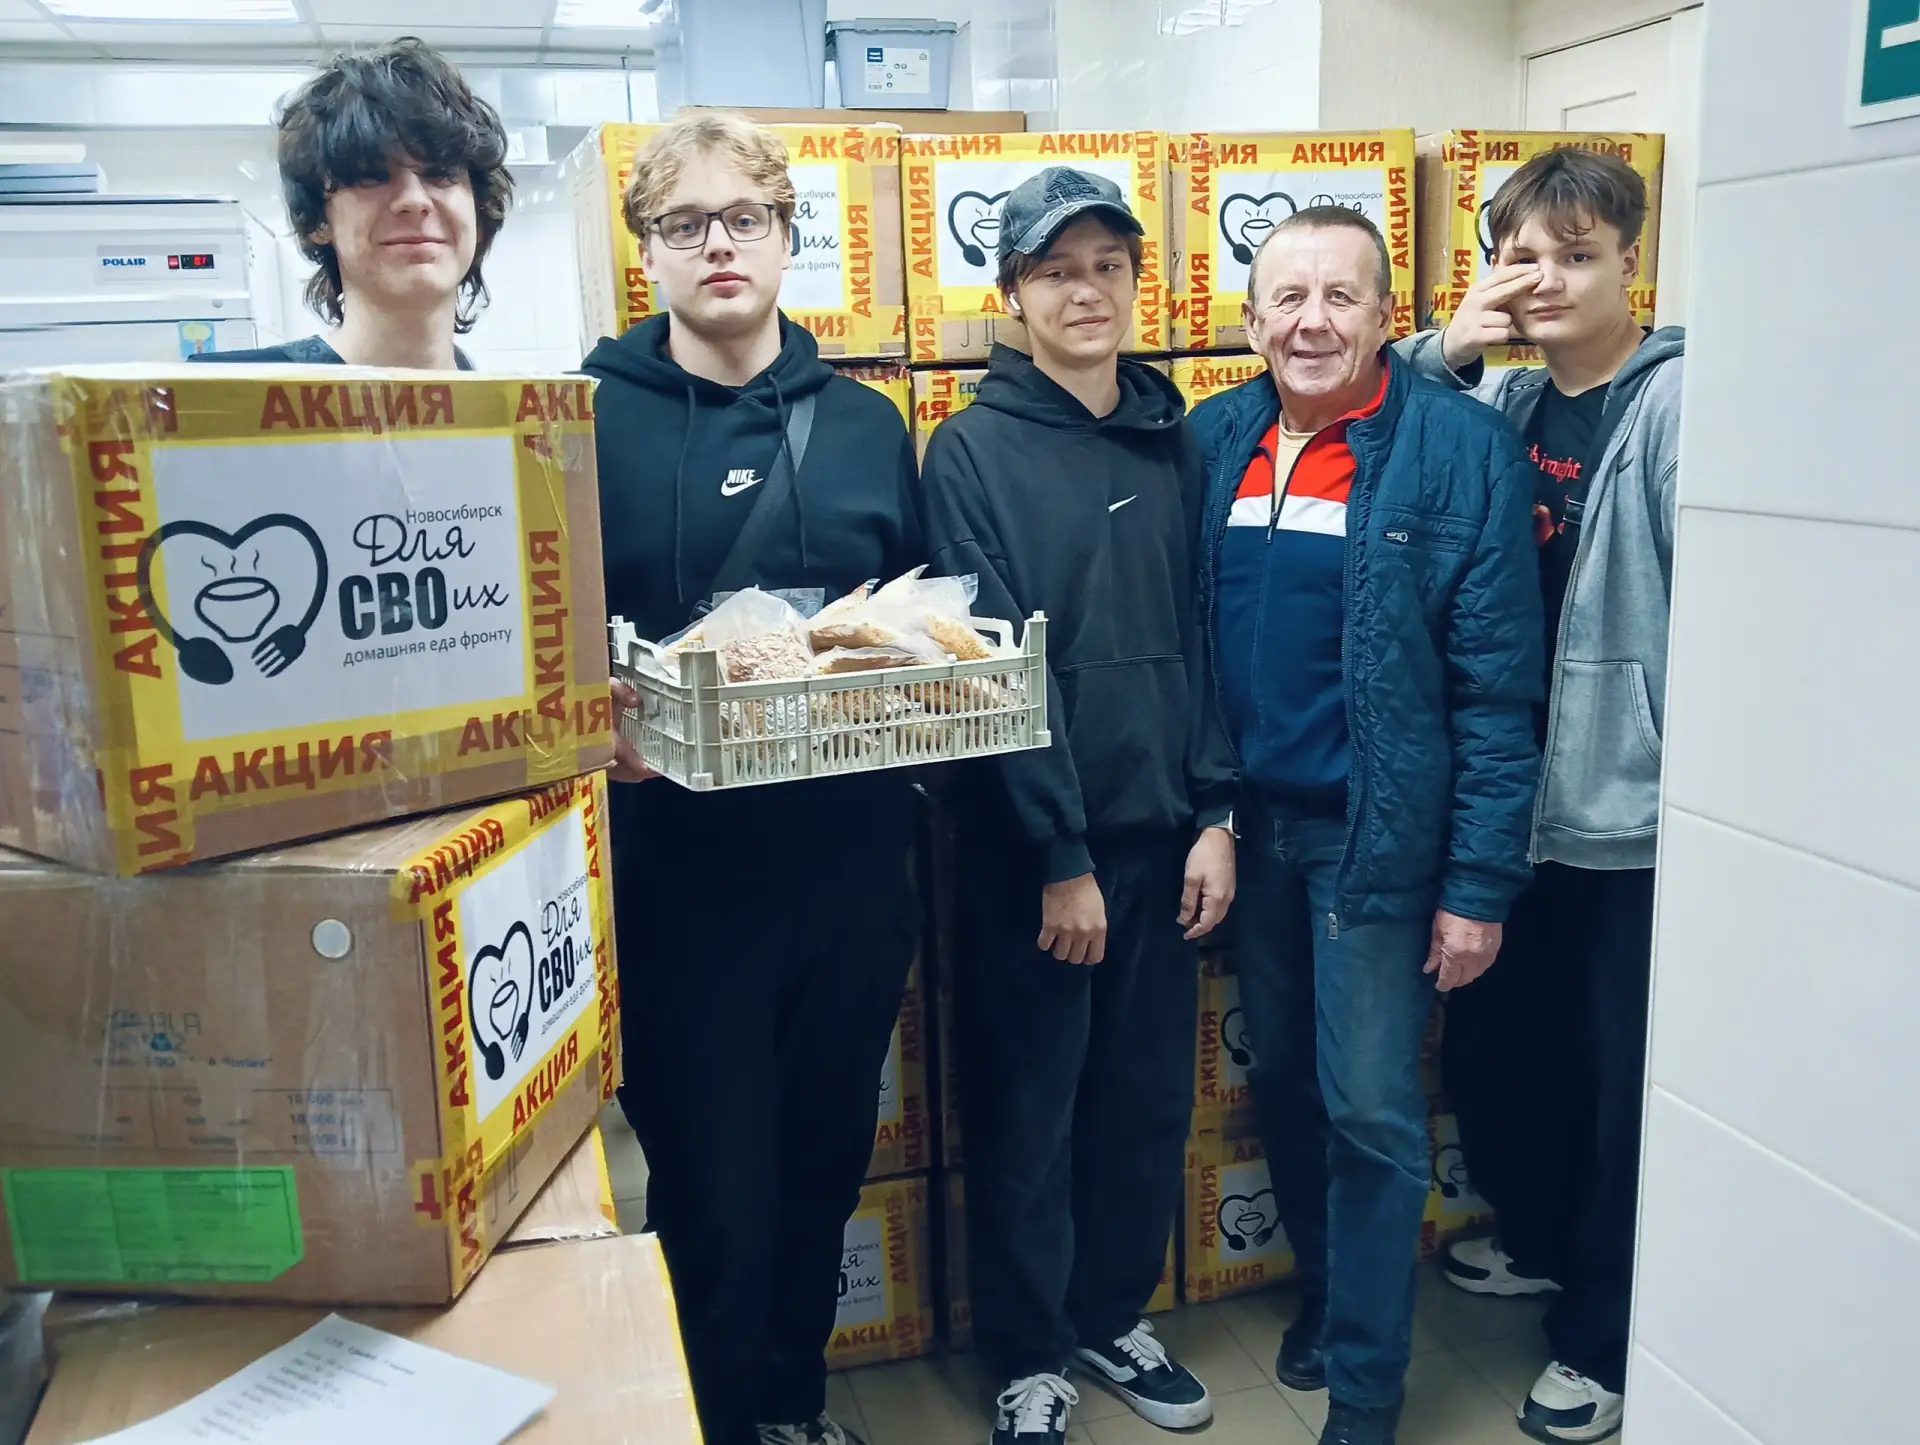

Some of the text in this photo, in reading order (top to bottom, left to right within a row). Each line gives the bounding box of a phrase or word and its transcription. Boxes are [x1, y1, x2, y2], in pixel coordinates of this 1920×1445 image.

[798, 136, 898, 158] АКИЯ
[1291, 142, 1385, 166] АКЦИЯ
[909, 166, 935, 279] АКЦИЯ
[1388, 167, 1411, 269] АКЦИЯ
[102, 258, 147, 267] POLAIR
[848, 204, 873, 318] АКЦИЯ
[260, 383, 455, 435] АКЦИЯ
[405, 503, 502, 525] Новосибирск
[726, 469, 756, 484] NIKE
[88, 440, 163, 680] АКЦИЯ
[352, 513, 476, 567] Для
[343, 627, 513, 668] домашняя еда фронту
[528, 530, 569, 721] АКЦИЯ
[189, 729, 393, 802] АКЦИЯ
[457, 696, 613, 757] АКЦИЯ
[409, 818, 506, 904] АКЦИЯ
[541, 897, 582, 948] Для
[433, 898, 470, 1107] АКЦИЯ
[512, 1030, 578, 1136] АКЦИЯ
[1200, 1010, 1221, 1098] АКЦИЯ
[885, 1190, 910, 1284] АКЦИЯ
[1199, 1165, 1219, 1249] АКЦИЯ
